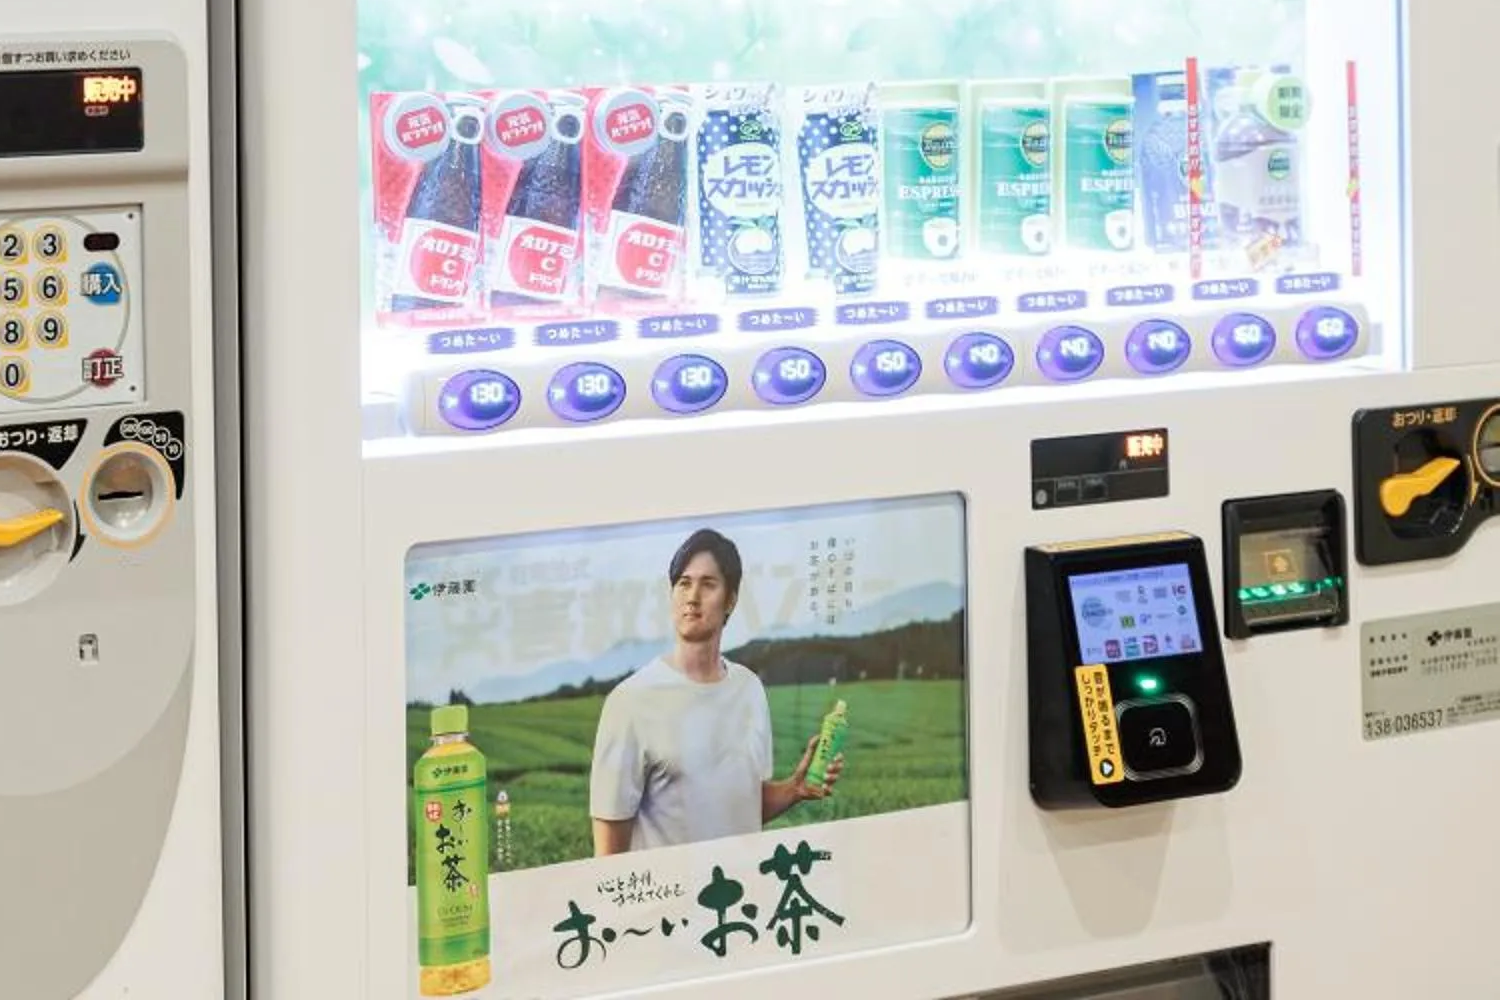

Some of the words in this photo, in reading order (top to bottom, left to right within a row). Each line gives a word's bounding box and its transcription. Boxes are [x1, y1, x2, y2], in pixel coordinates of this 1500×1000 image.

[4, 234, 18, 257] 2
[43, 233, 57, 256] 3
[443, 259, 457, 274] C
[541, 258, 557, 273] C
[649, 254, 664, 269] C
[4, 278, 18, 300] 5
[43, 276, 57, 298] 6
[80, 272, 121, 296] 購入
[4, 321, 19, 343] 8
[43, 318, 58, 341] 9
[5, 363, 19, 387] 0
[82, 356, 124, 379] 訂正
[680, 365, 711, 387] 130
[779, 359, 811, 380] 150
[470, 381, 505, 403] 130
[577, 374, 609, 395] 130
[435, 823, 470, 893] お茶
